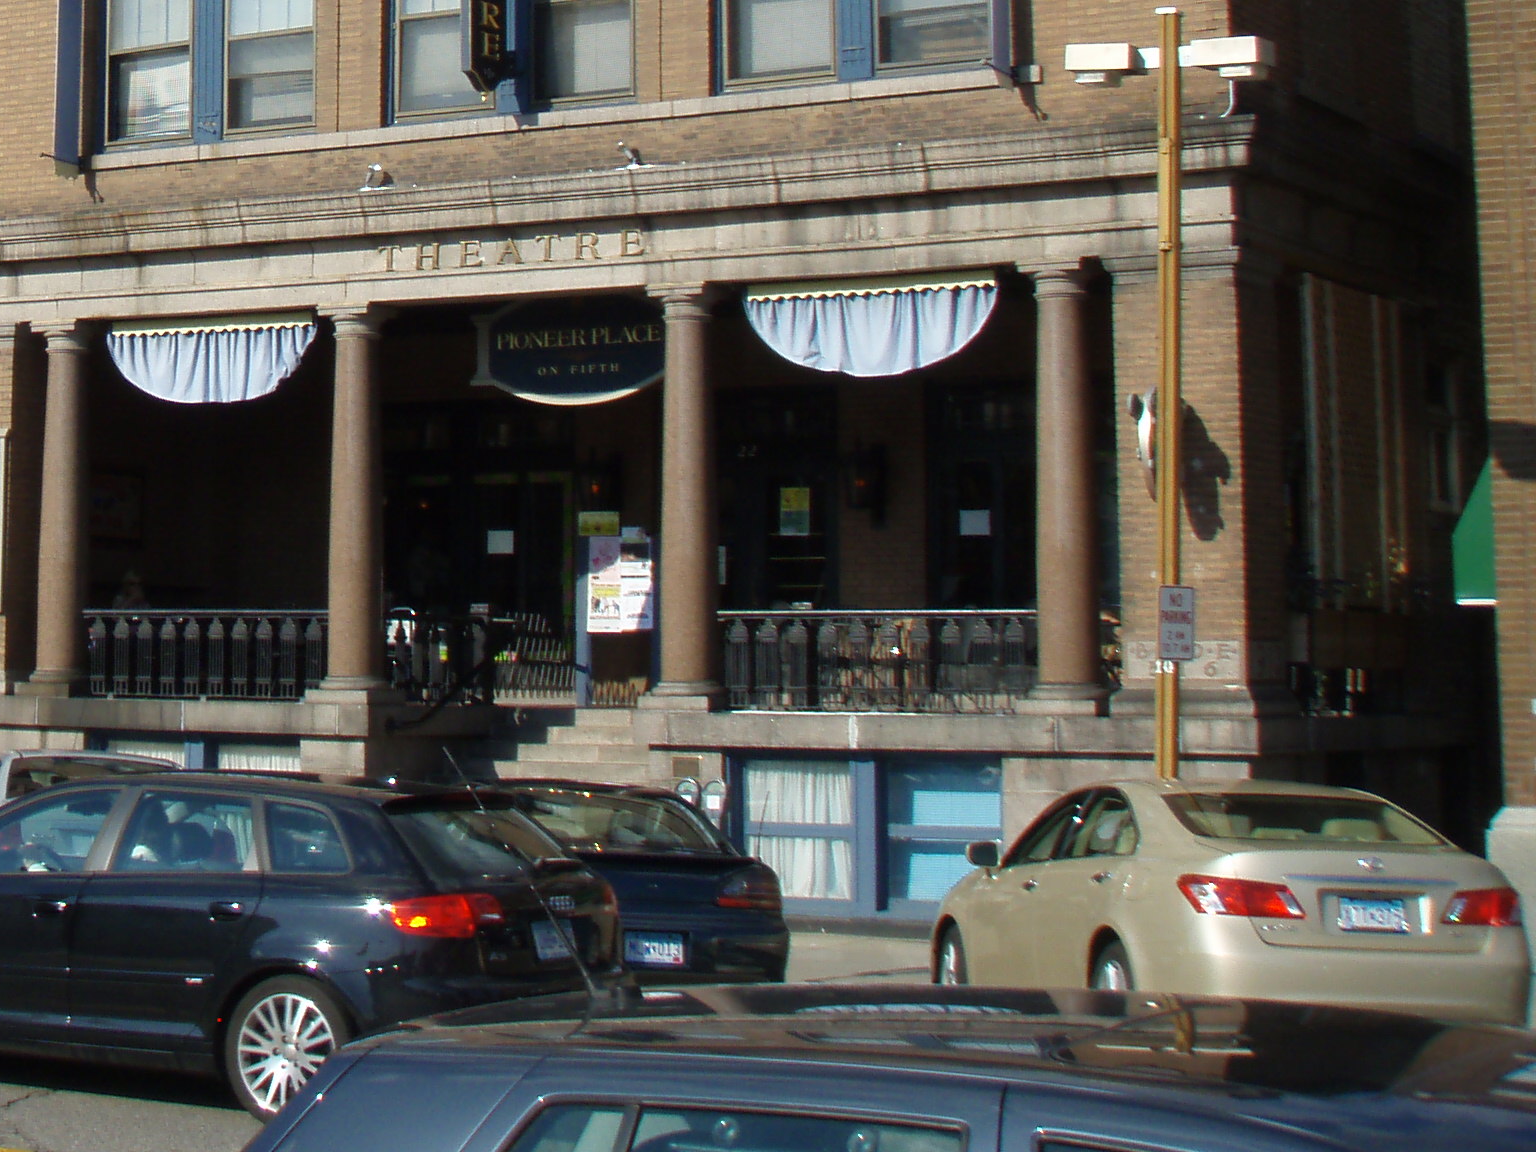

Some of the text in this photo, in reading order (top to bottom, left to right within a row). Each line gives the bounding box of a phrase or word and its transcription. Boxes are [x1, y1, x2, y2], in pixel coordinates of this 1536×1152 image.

[378, 228, 645, 272] THEATRE
[497, 324, 662, 350] PIONEER PLACE
[537, 362, 620, 376] ON FIFTH
[1169, 593, 1183, 607] NO
[1160, 610, 1192, 624] PARKING
[1155, 660, 1174, 674] 10
